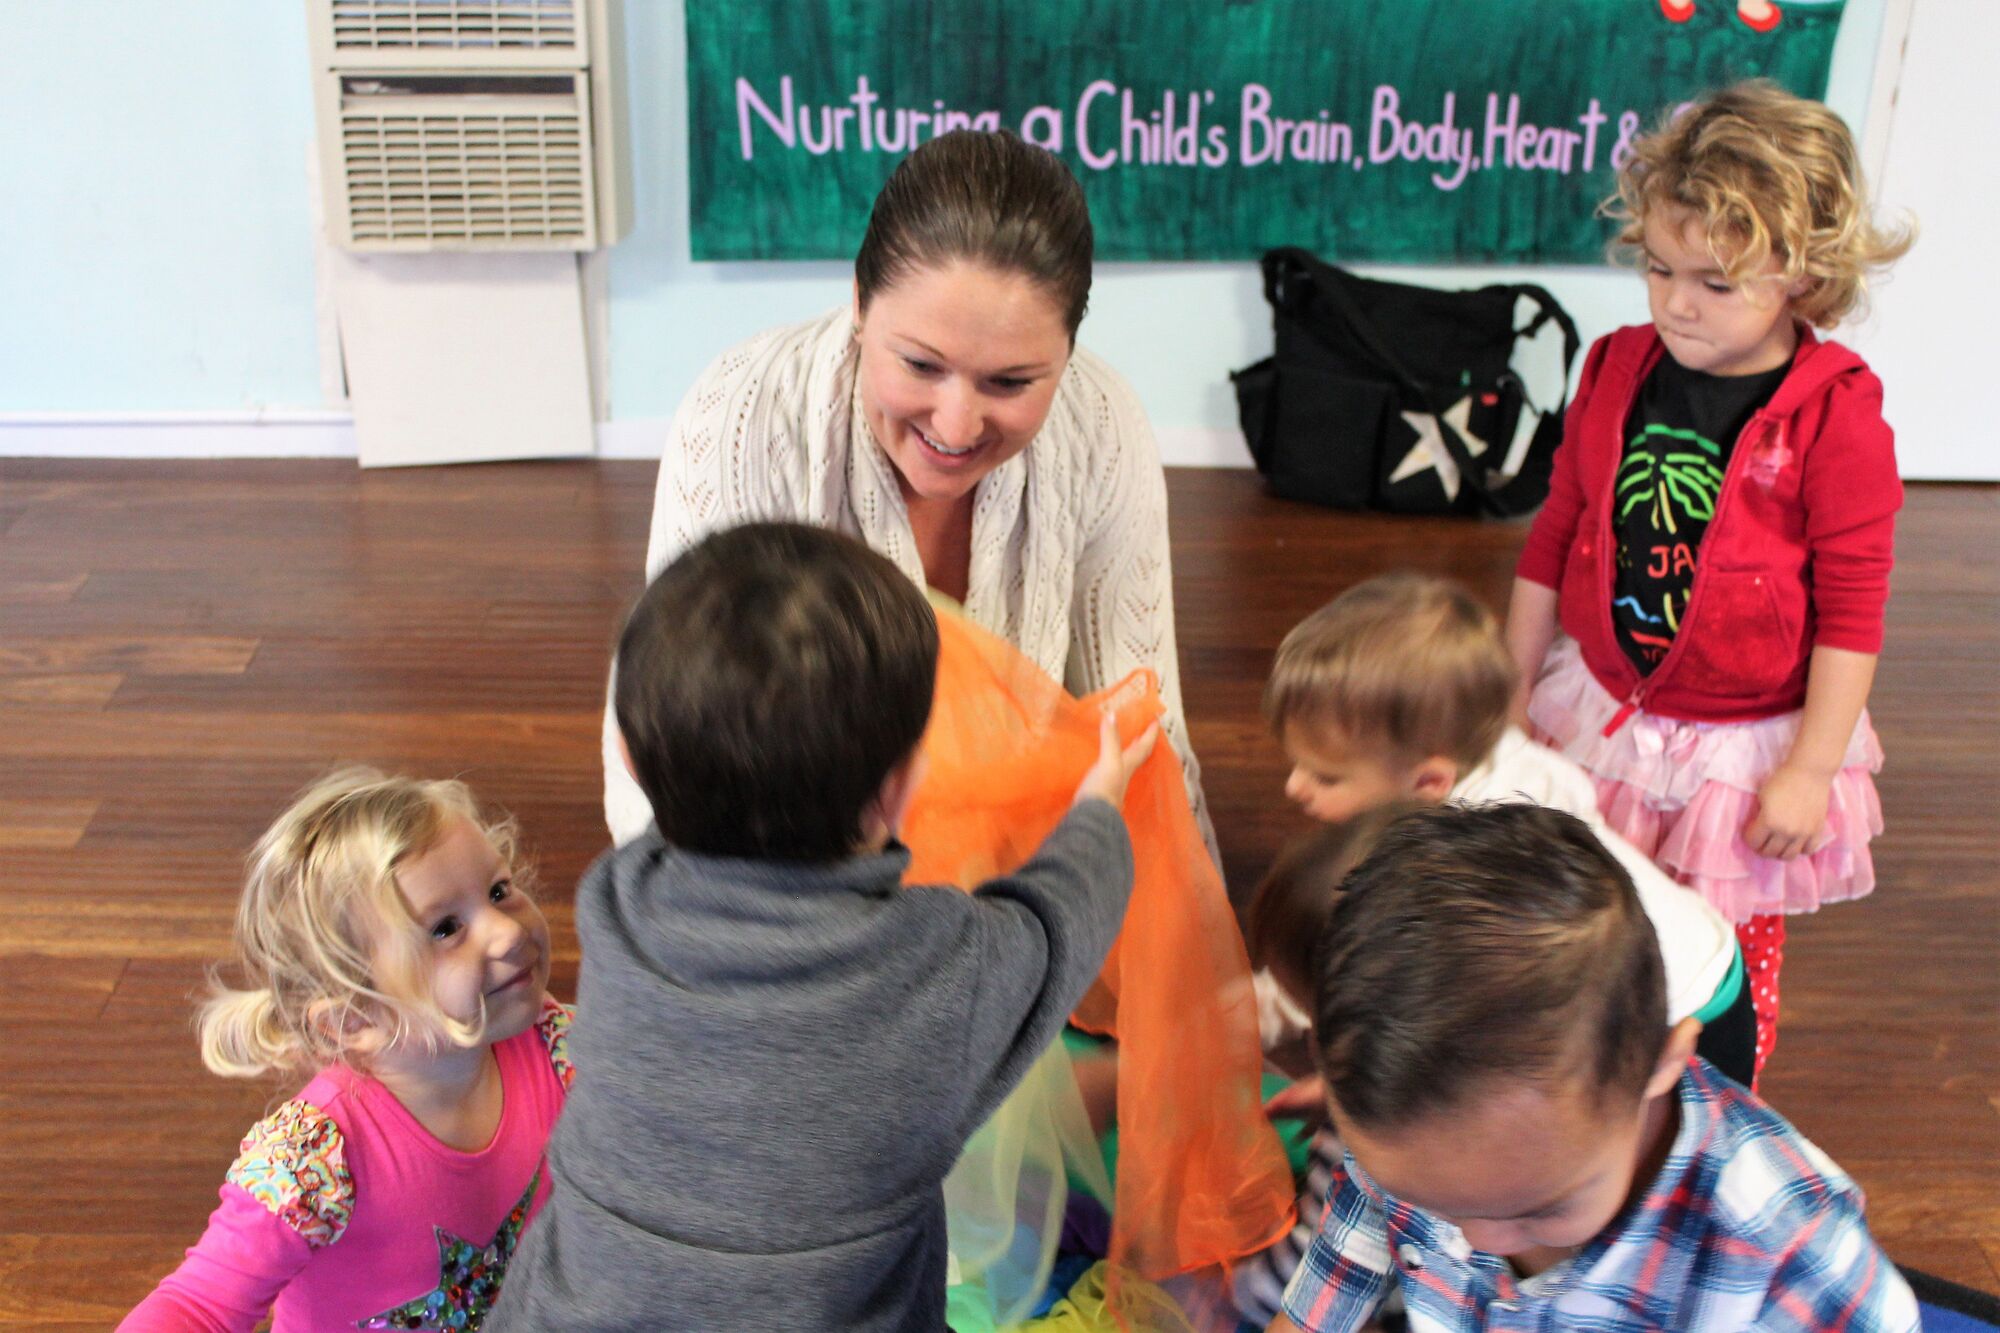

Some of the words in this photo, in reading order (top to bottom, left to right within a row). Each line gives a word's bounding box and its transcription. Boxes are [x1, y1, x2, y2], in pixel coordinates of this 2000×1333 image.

[1020, 104, 1063, 152] a
[1075, 79, 1228, 169] Child's
[1240, 82, 1363, 170] Brain,
[1369, 84, 1480, 190] Body,
[1483, 91, 1607, 173] Heart
[1610, 109, 1646, 171] &
[1647, 542, 1699, 578] JA
